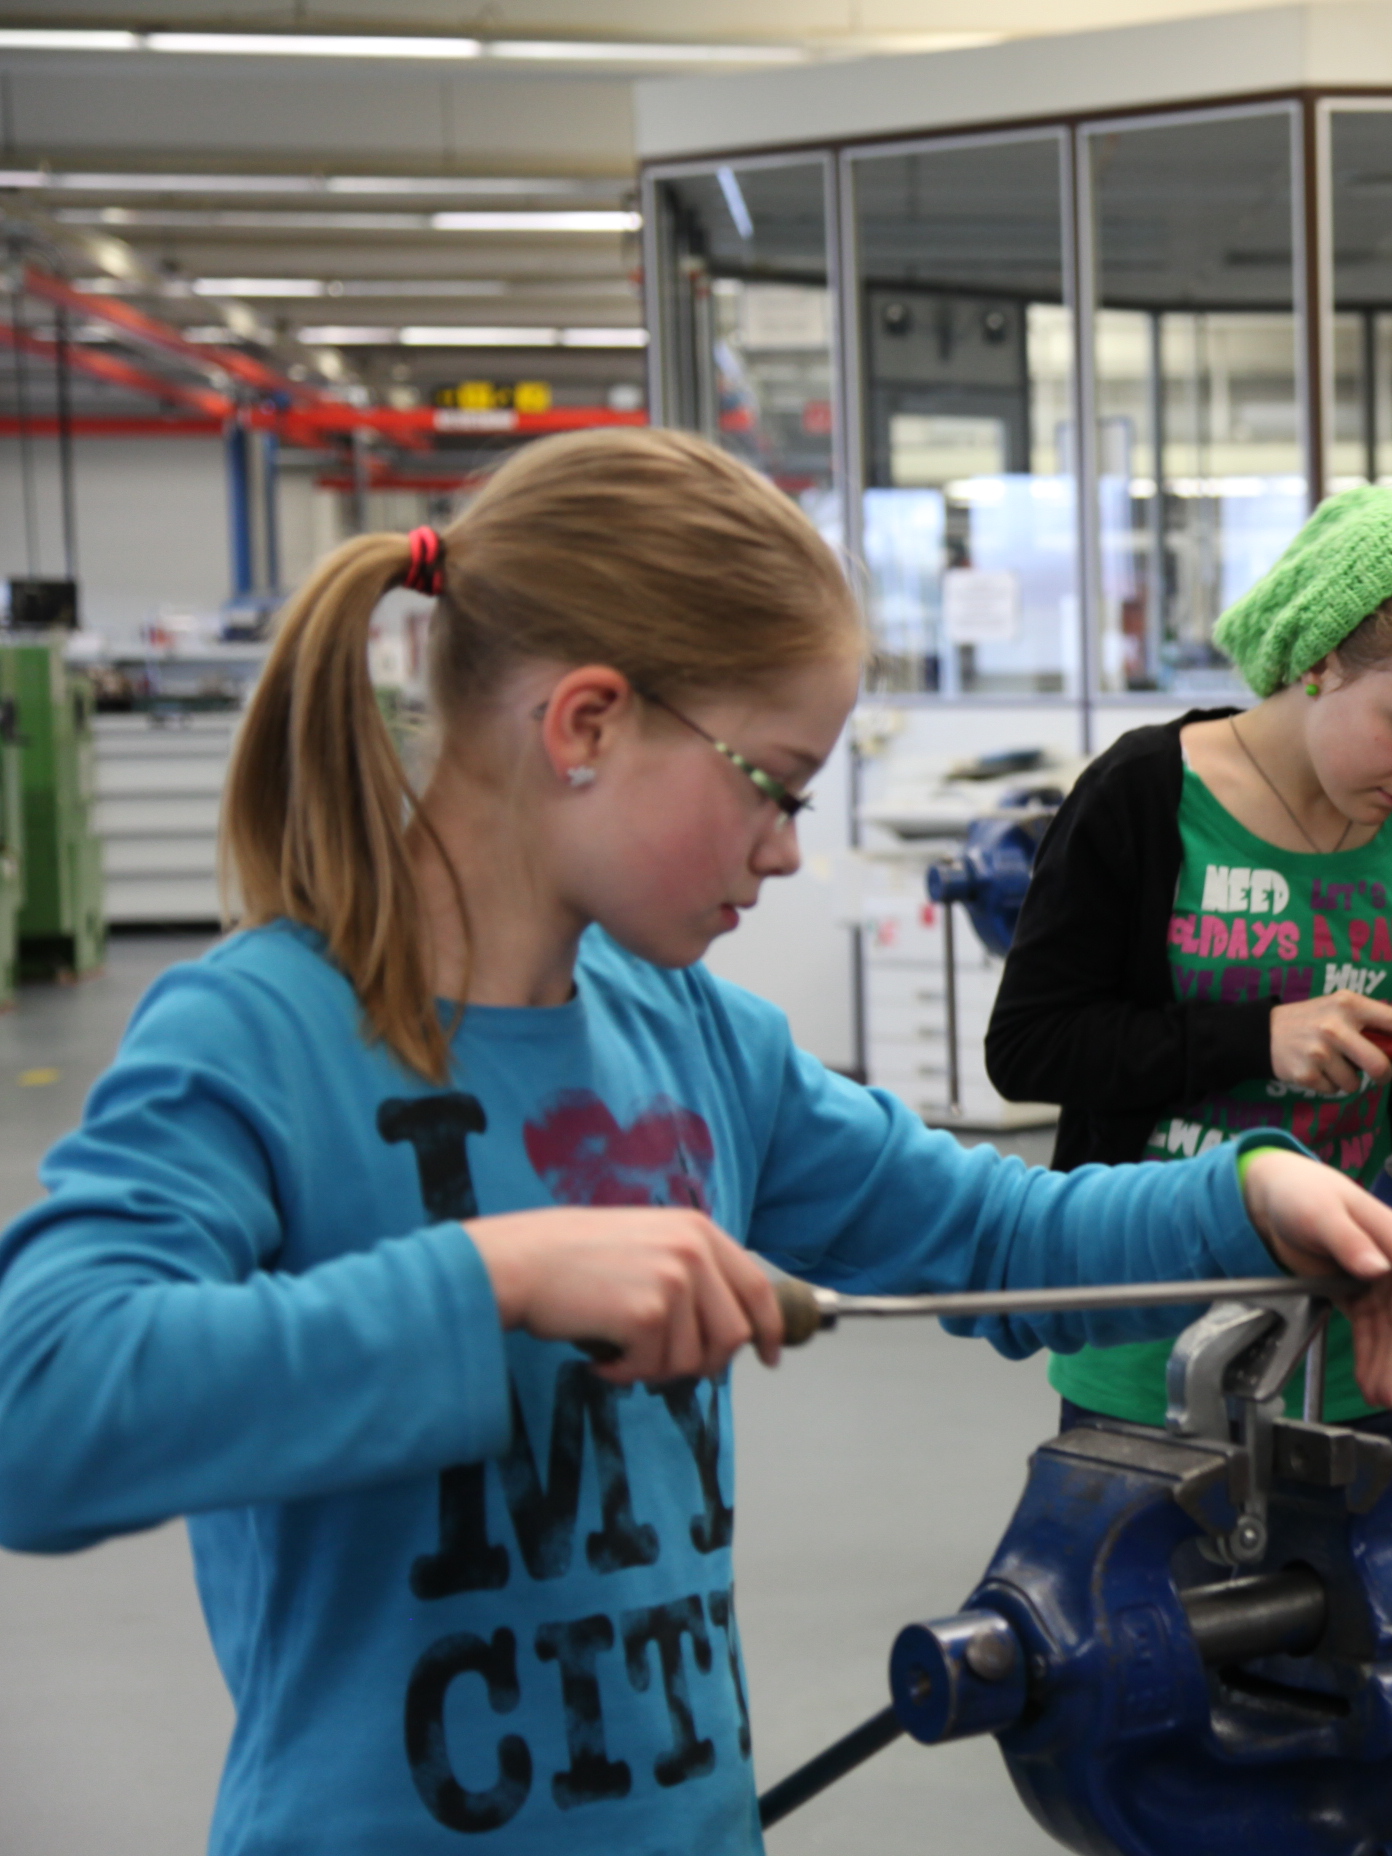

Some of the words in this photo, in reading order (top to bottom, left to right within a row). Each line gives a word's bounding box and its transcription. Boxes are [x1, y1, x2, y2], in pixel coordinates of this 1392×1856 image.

[1201, 865, 1290, 915] NEED
[1313, 914, 1338, 958] A
[1323, 962, 1387, 997] WHY
